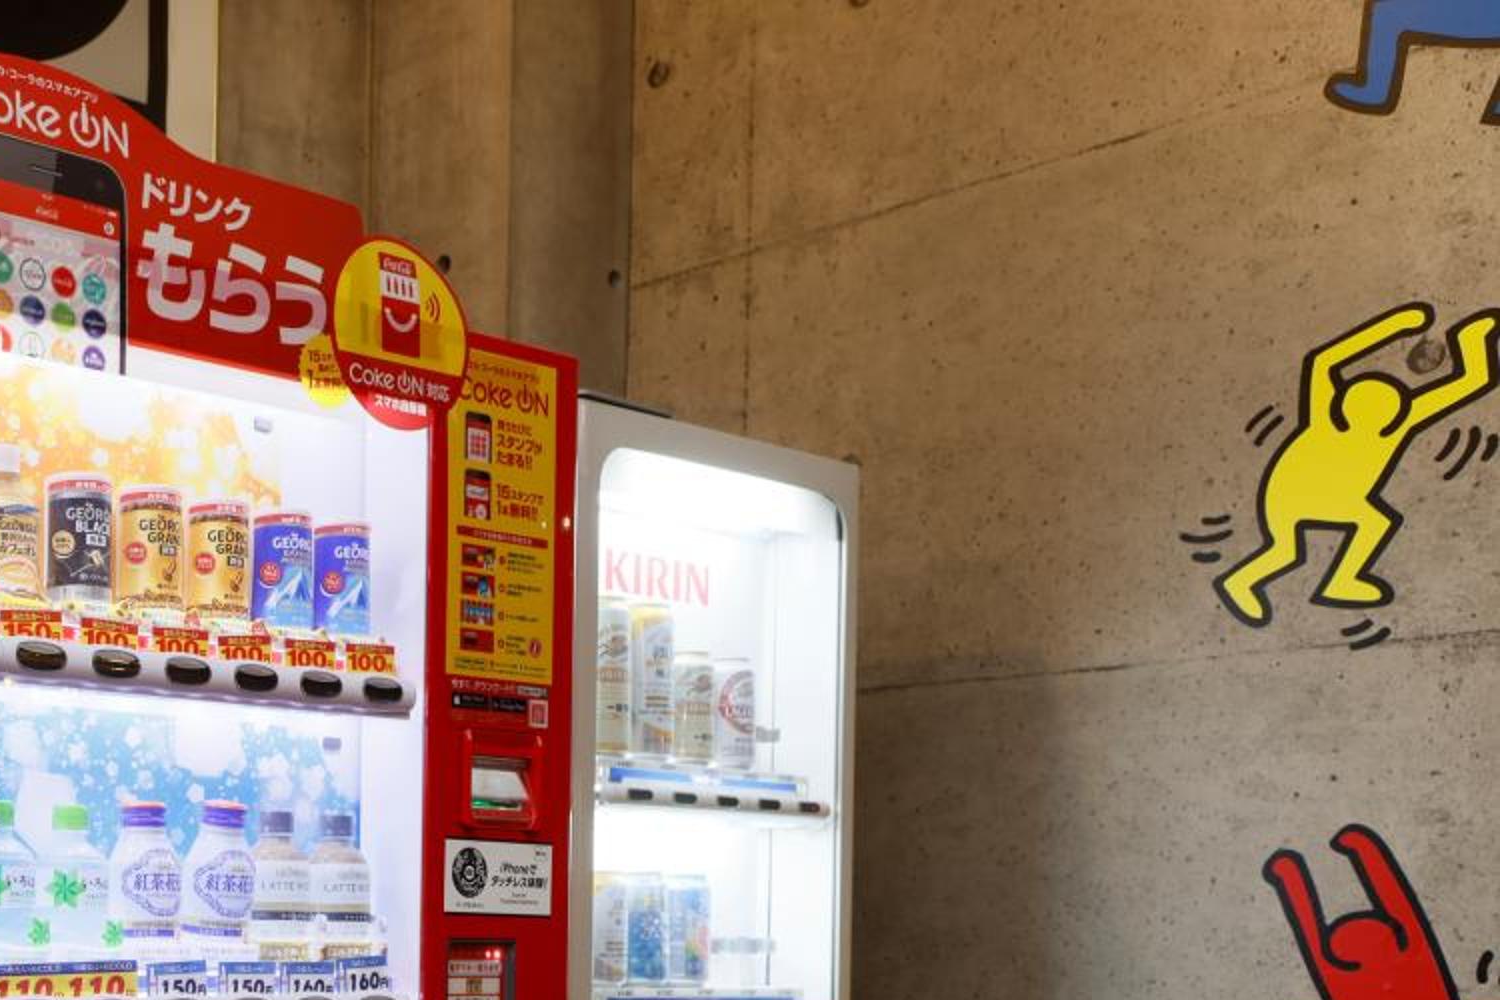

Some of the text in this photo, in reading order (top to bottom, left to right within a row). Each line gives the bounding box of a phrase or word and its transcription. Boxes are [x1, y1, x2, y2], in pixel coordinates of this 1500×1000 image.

[69, 101, 130, 159] ON
[140, 172, 252, 232] ドリンク
[349, 362, 395, 390] Coke
[397, 371, 425, 396] ON
[461, 376, 549, 417] Coke ON
[604, 547, 710, 607] KIRIN
[349, 971, 390, 990] 160円
